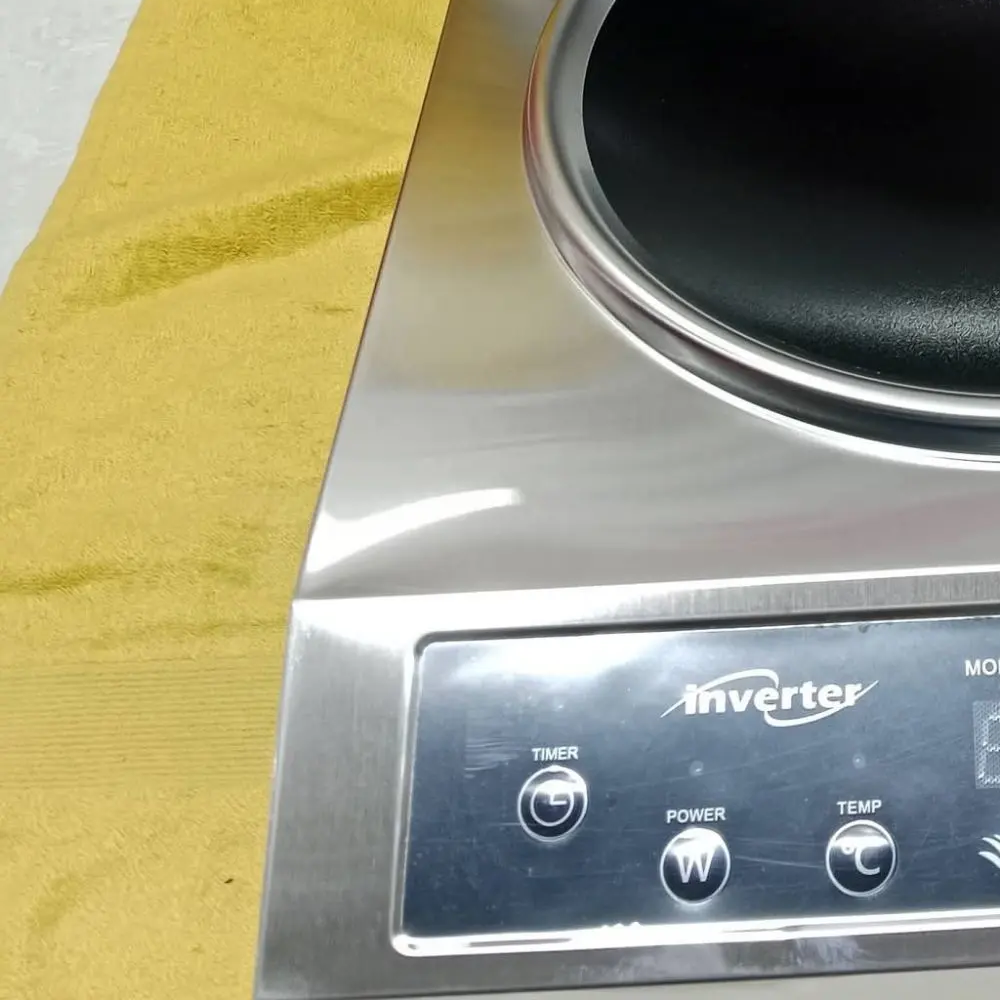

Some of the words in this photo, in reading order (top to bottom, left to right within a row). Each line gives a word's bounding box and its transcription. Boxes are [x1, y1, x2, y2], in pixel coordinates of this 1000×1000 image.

[677, 675, 867, 720] inverter
[531, 746, 579, 762] TIMER
[666, 806, 727, 824] POWER
[837, 799, 883, 816] TEMP
[676, 849, 714, 884] W
